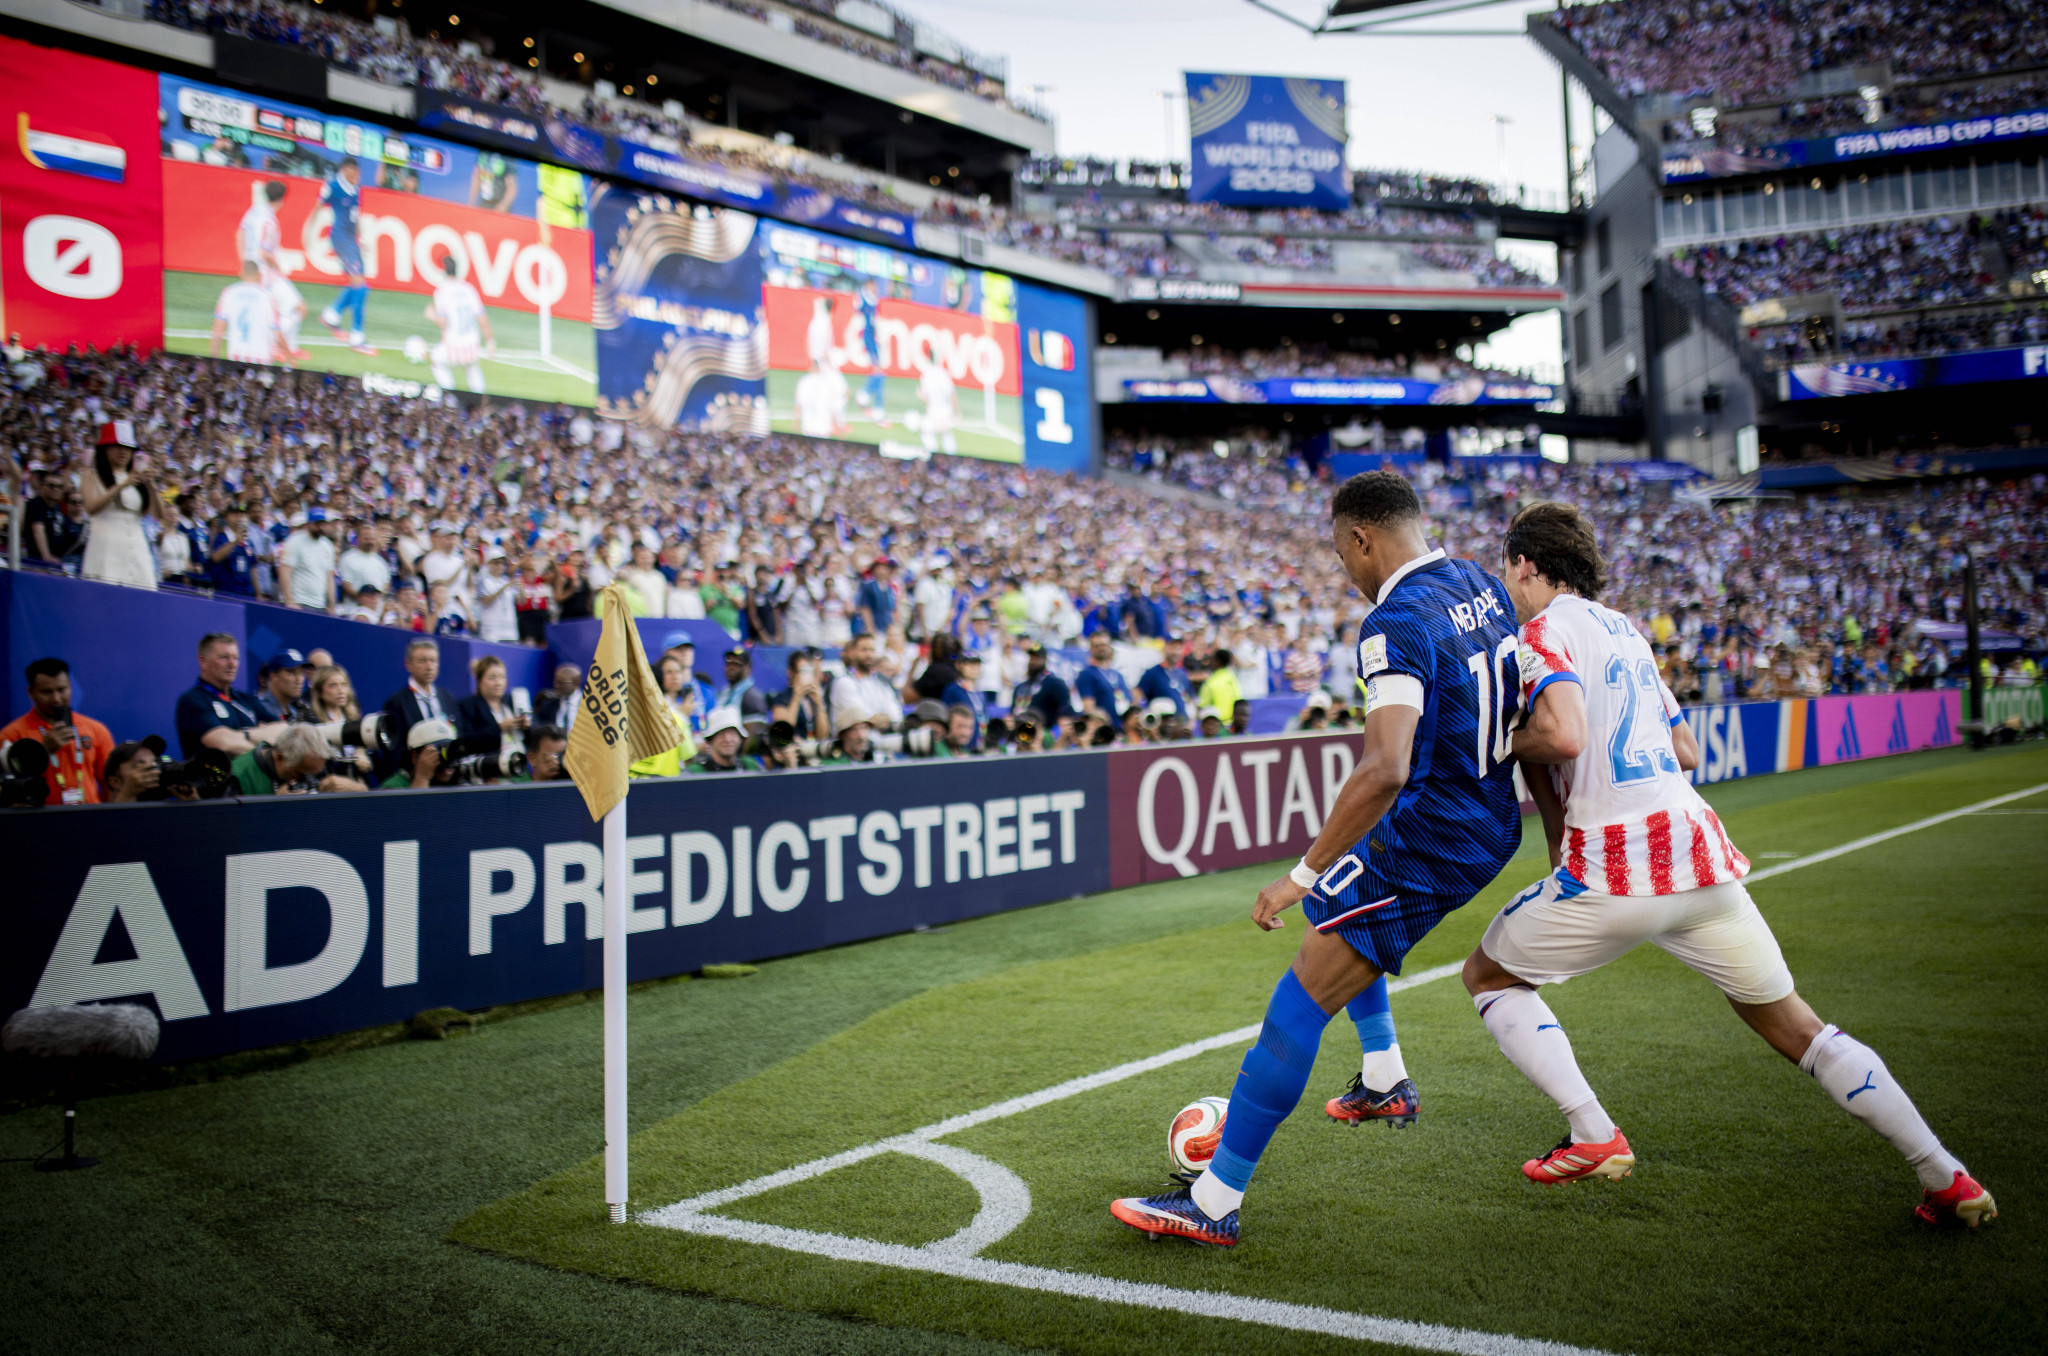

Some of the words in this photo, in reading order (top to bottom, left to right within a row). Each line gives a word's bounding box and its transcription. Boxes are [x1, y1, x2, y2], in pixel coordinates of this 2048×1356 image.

[1202, 143, 1293, 169] WORLD
[1294, 147, 1340, 172] CUP
[1246, 121, 1300, 146] FIFA
[1835, 133, 1879, 156] FIFA
[1878, 124, 1951, 151] WORLD
[1951, 118, 1992, 141] CUP
[1993, 112, 2048, 136] 202
[277, 205, 568, 308] enovo
[828, 313, 1004, 386] enovo
[1034, 387, 1074, 444] 1
[590, 659, 622, 716] ORLD
[610, 668, 628, 705] FI
[1467, 634, 1525, 779] 10
[1604, 653, 1679, 789] 23
[28, 840, 420, 1021] ADI
[468, 790, 1085, 956] PREDICTSTREET
